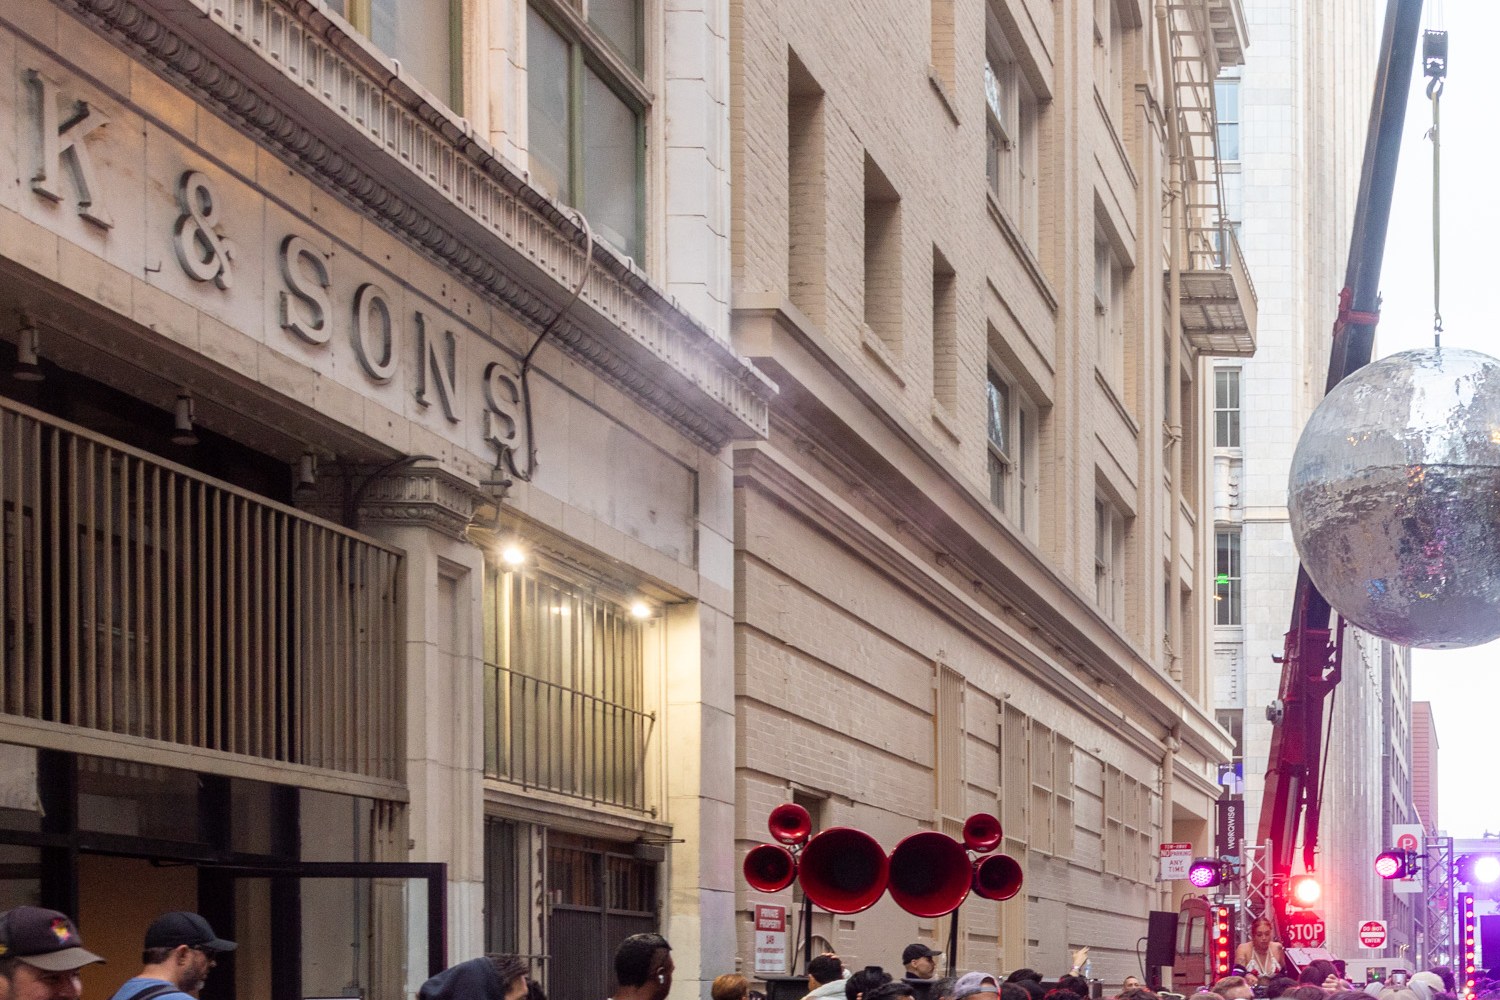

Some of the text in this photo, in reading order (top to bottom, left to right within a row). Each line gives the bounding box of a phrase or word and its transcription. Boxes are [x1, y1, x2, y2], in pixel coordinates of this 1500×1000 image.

[26, 68, 526, 455] K & SONS
[761, 908, 779, 919] PRIVATE
[759, 918, 781, 929] PROPERTY
[1287, 924, 1324, 940] STOP
